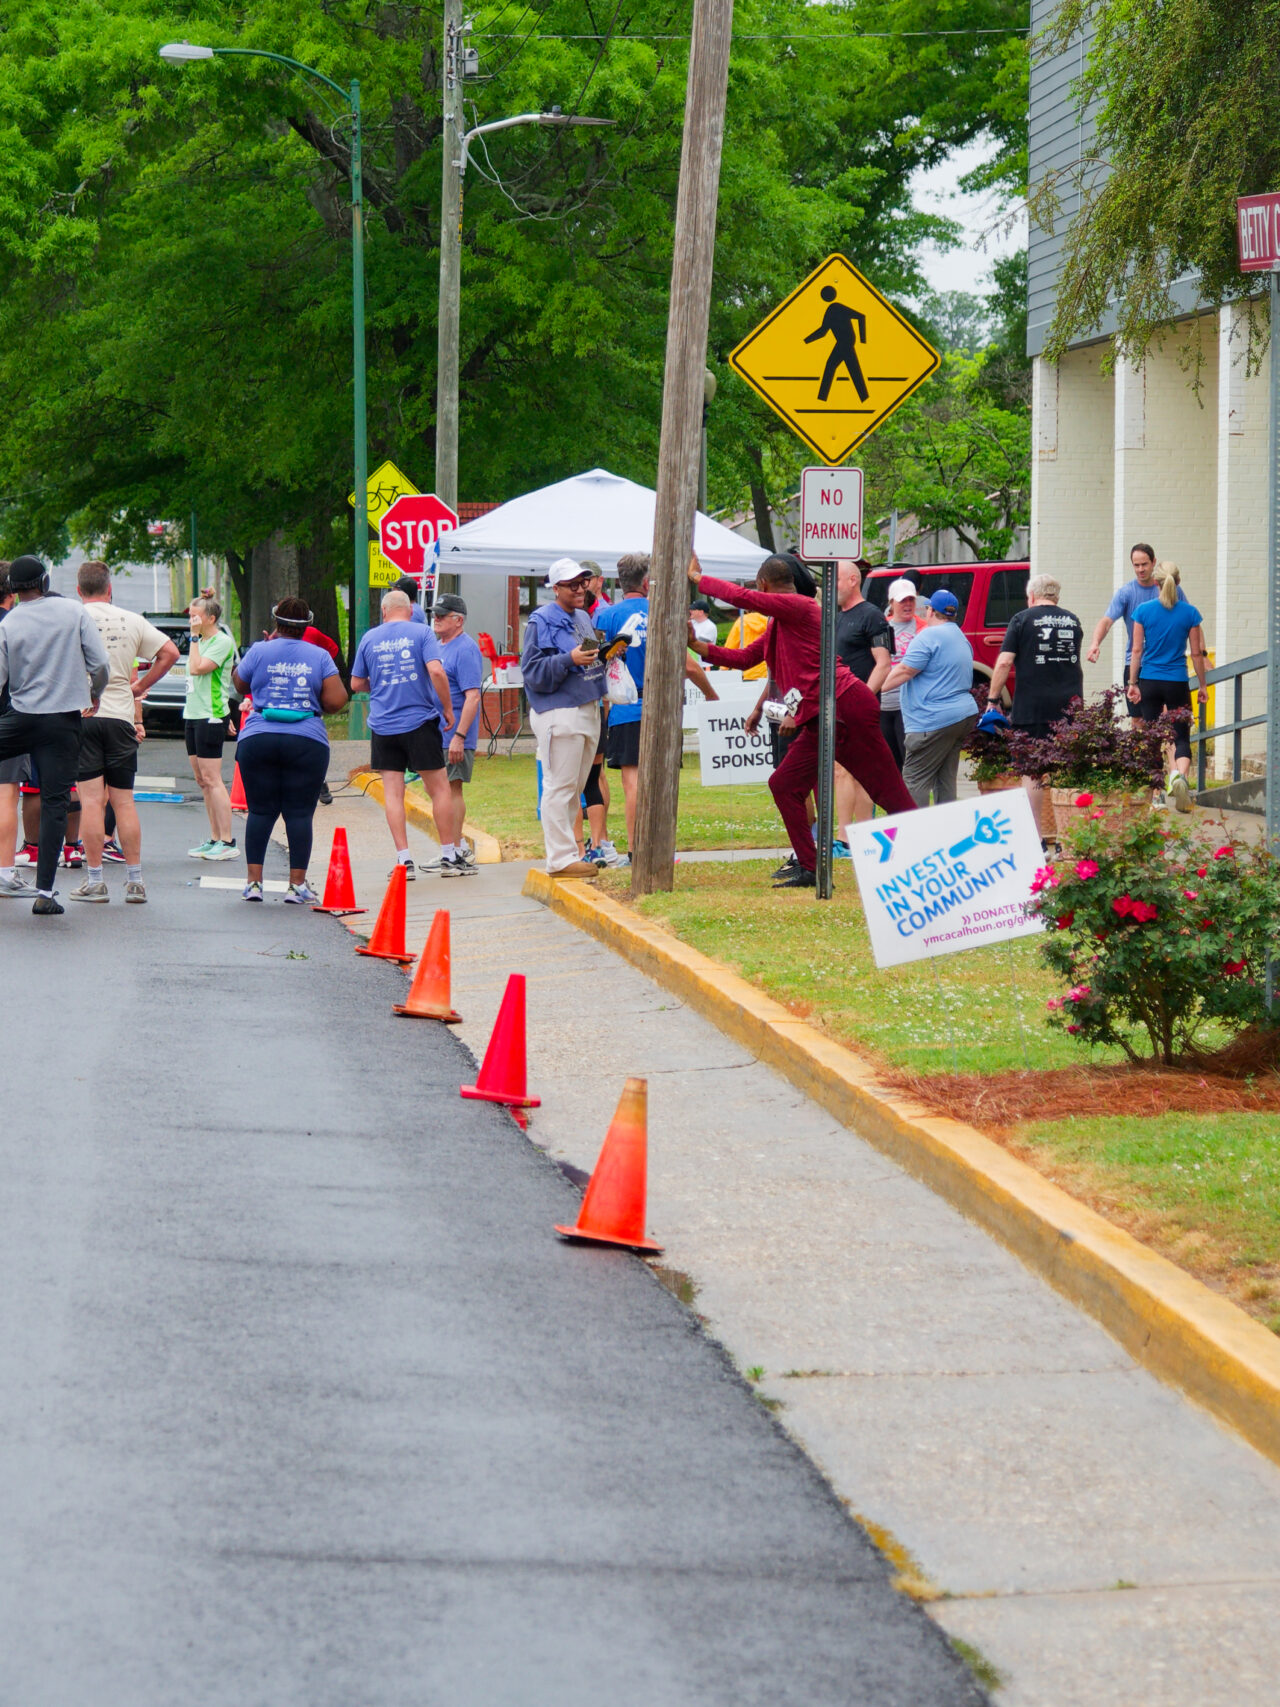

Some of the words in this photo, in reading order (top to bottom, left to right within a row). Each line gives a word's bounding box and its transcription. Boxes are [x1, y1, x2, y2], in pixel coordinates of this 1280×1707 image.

[1240, 205, 1270, 259] BETTY
[821, 488, 843, 506] NO
[386, 519, 453, 550] STOP
[805, 522, 858, 540] PARKING
[378, 559, 393, 569] THE
[373, 572, 397, 582] ROAD
[708, 716, 763, 732] THAN
[725, 735, 746, 749] TO
[751, 734, 773, 748] OU
[712, 751, 774, 769] SPONSO
[875, 848, 948, 903] INVEST
[886, 895, 913, 921] IN
[911, 861, 971, 902] YOUR
[896, 853, 1018, 937] COMMUNITY
[973, 903, 1017, 922] DONATE
